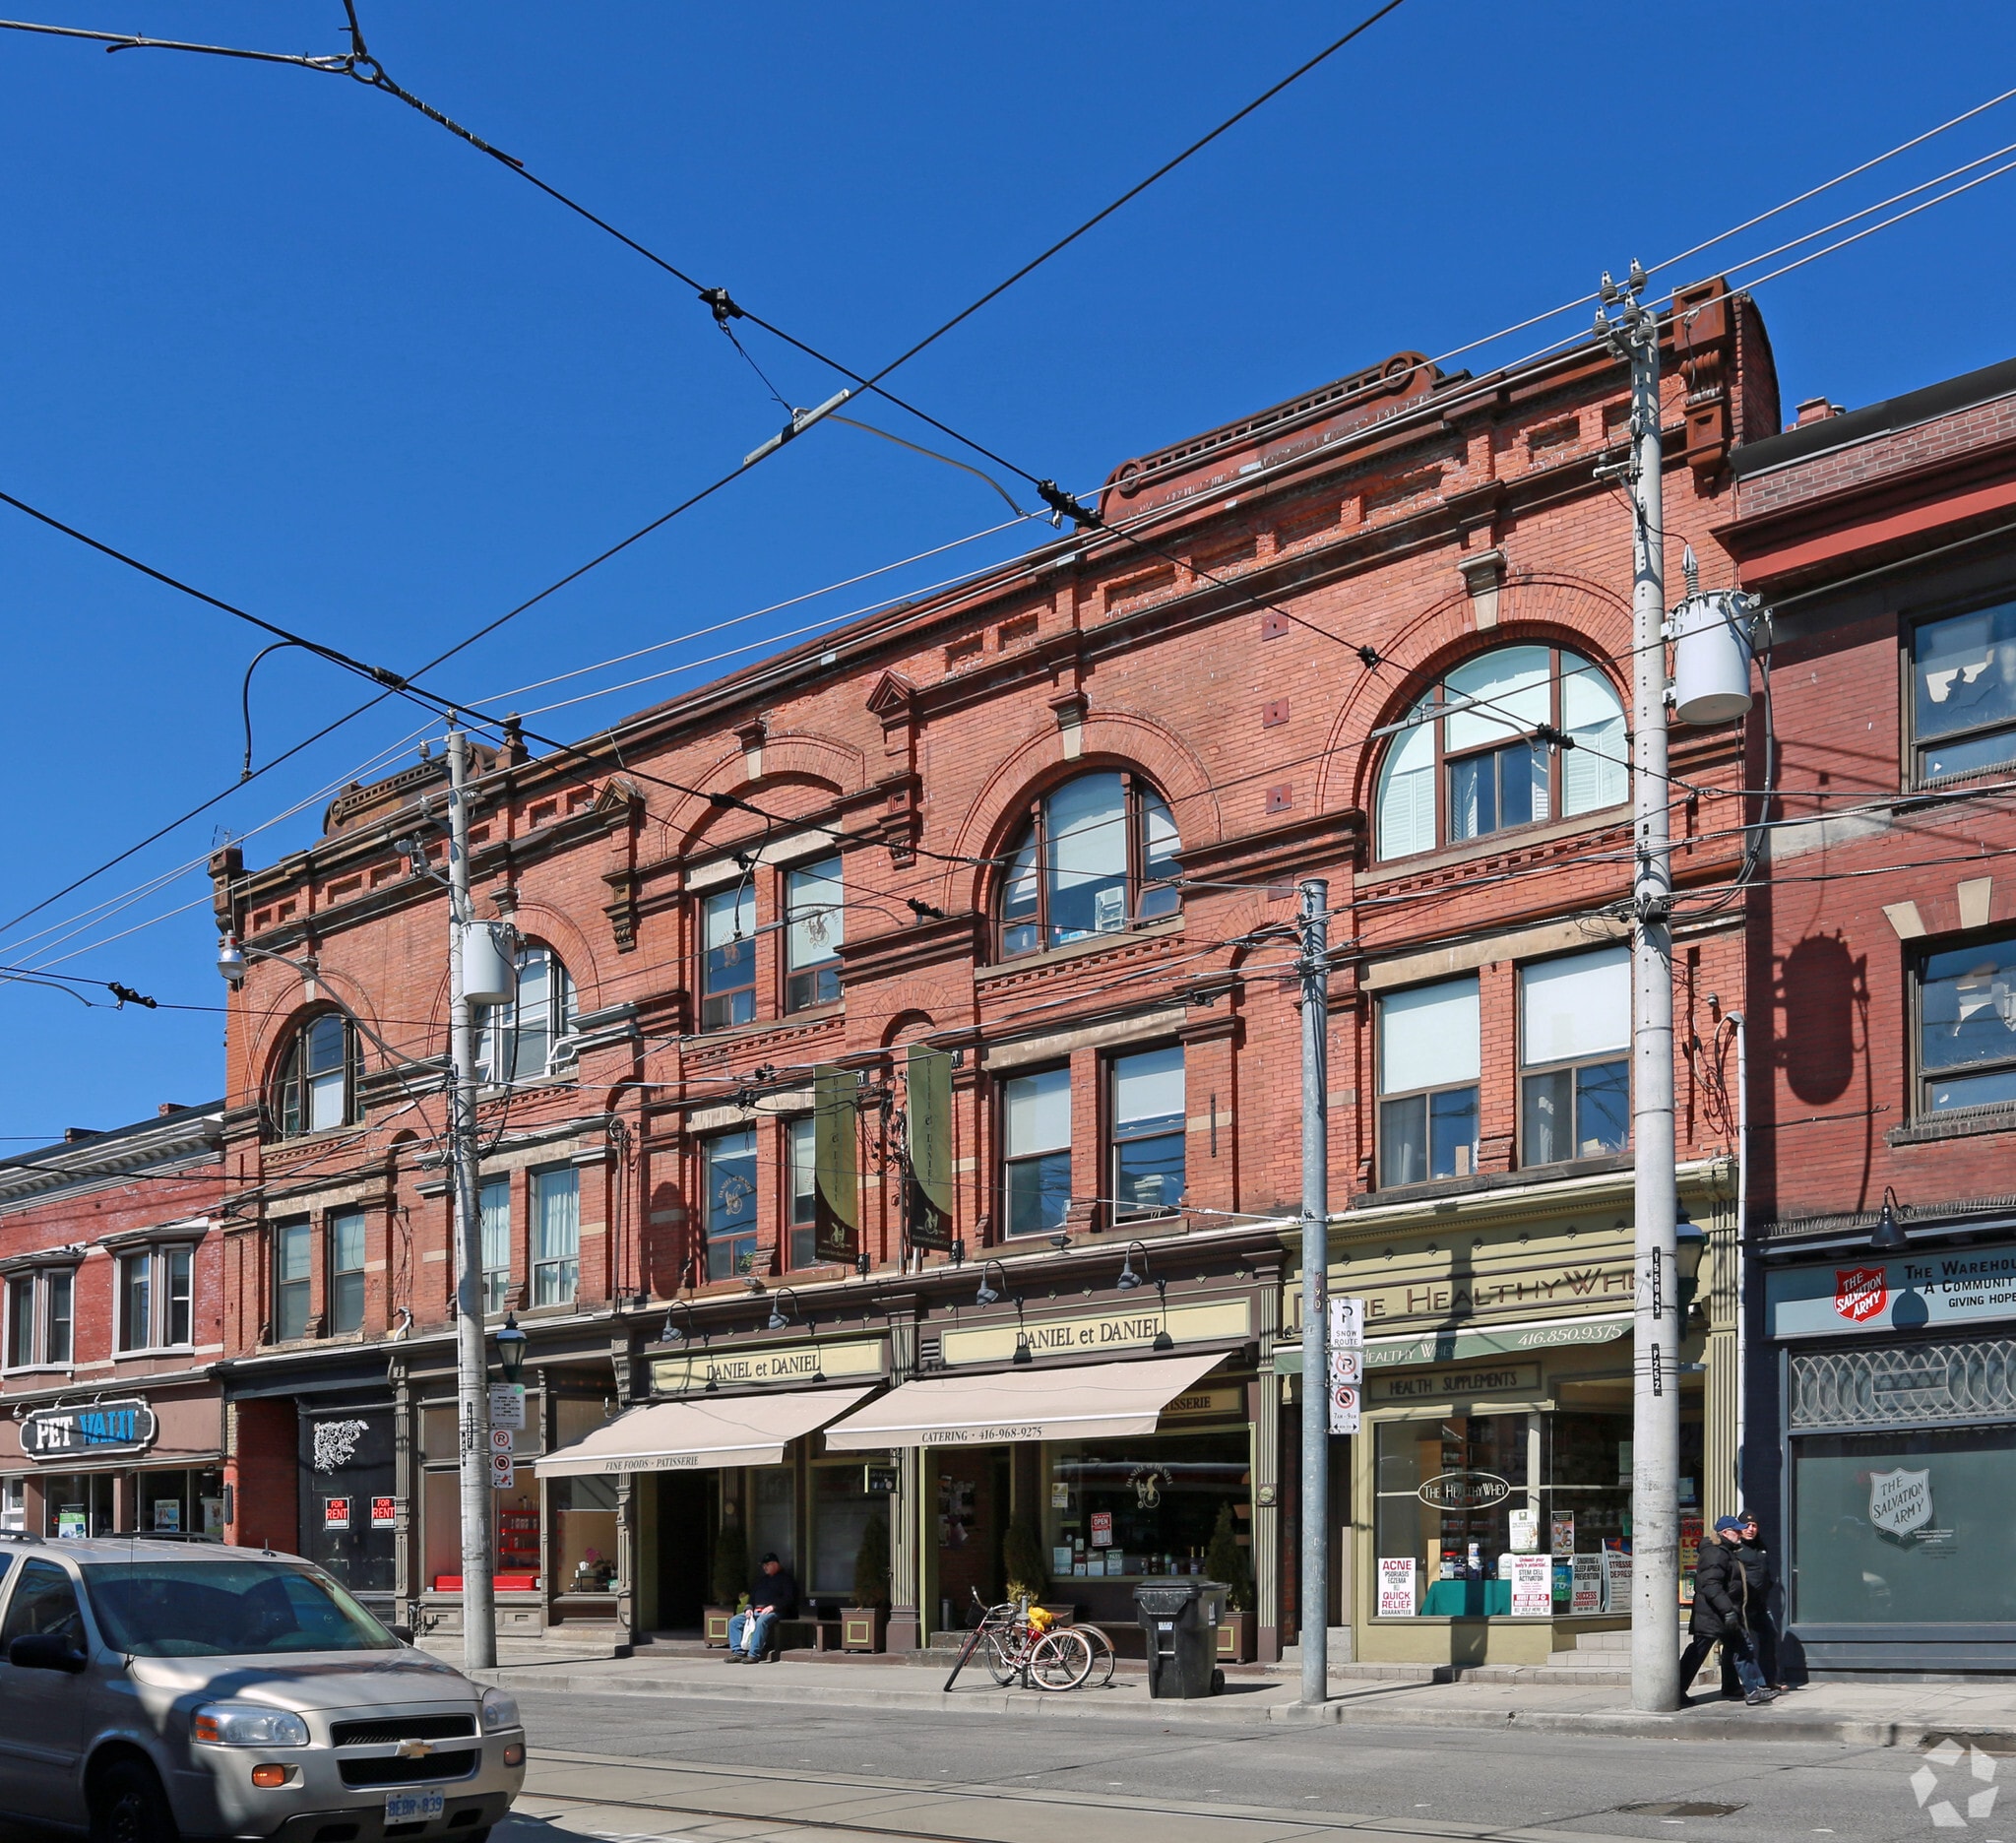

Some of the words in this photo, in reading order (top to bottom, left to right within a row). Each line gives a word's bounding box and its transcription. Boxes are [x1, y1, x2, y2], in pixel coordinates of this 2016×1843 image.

[1904, 1264, 1933, 1280] THE
[1842, 1272, 1864, 1293] THE
[1923, 1282, 1935, 1295] A
[1407, 1279, 1561, 1313] HEALTHY
[1837, 1272, 1882, 1313] SALVATION
[1948, 1296, 1984, 1307] GIVING
[1988, 1292, 2016, 1305] HOPE
[1853, 1291, 1881, 1319] ARMY
[1016, 1327, 1075, 1350] DANIEL
[1079, 1327, 1095, 1345] et
[1100, 1317, 1160, 1343] DANIEL
[1420, 1341, 1458, 1360] WHEY
[1517, 1323, 1623, 1347] 416.850.9375
[706, 1361, 752, 1381] DANIEL
[755, 1362, 768, 1376] et
[771, 1355, 820, 1374] DANIEL
[1389, 1378, 1433, 1396] HEALTH
[1442, 1371, 1517, 1391] SUPPLEMENTS
[1163, 1396, 1211, 1411] ISSERIE
[35, 1415, 74, 1450] PET
[79, 1409, 136, 1444] VALU
[921, 1430, 968, 1443] CATERING
[978, 1427, 1042, 1440] 416-968-9275
[604, 1460, 622, 1471] FINE
[623, 1458, 649, 1470] FOODS
[656, 1455, 700, 1468] PATISSERIE
[1423, 1485, 1440, 1498] THE
[1481, 1482, 1506, 1496] WHEY
[1880, 1476, 1904, 1495] THE
[1873, 1479, 1924, 1519] SALVATION
[326, 1507, 347, 1519] RENT
[372, 1506, 395, 1518] RENT
[1893, 1497, 1924, 1527] ARMY
[1093, 1517, 1108, 1526] OPEN
[1382, 1560, 1412, 1570] ACNE
[1382, 1591, 1411, 1600] QUICK
[1575, 1591, 1597, 1600] SUCCESS
[1381, 1600, 1412, 1609] RELIEF
[421, 1796, 443, 1813] 839
